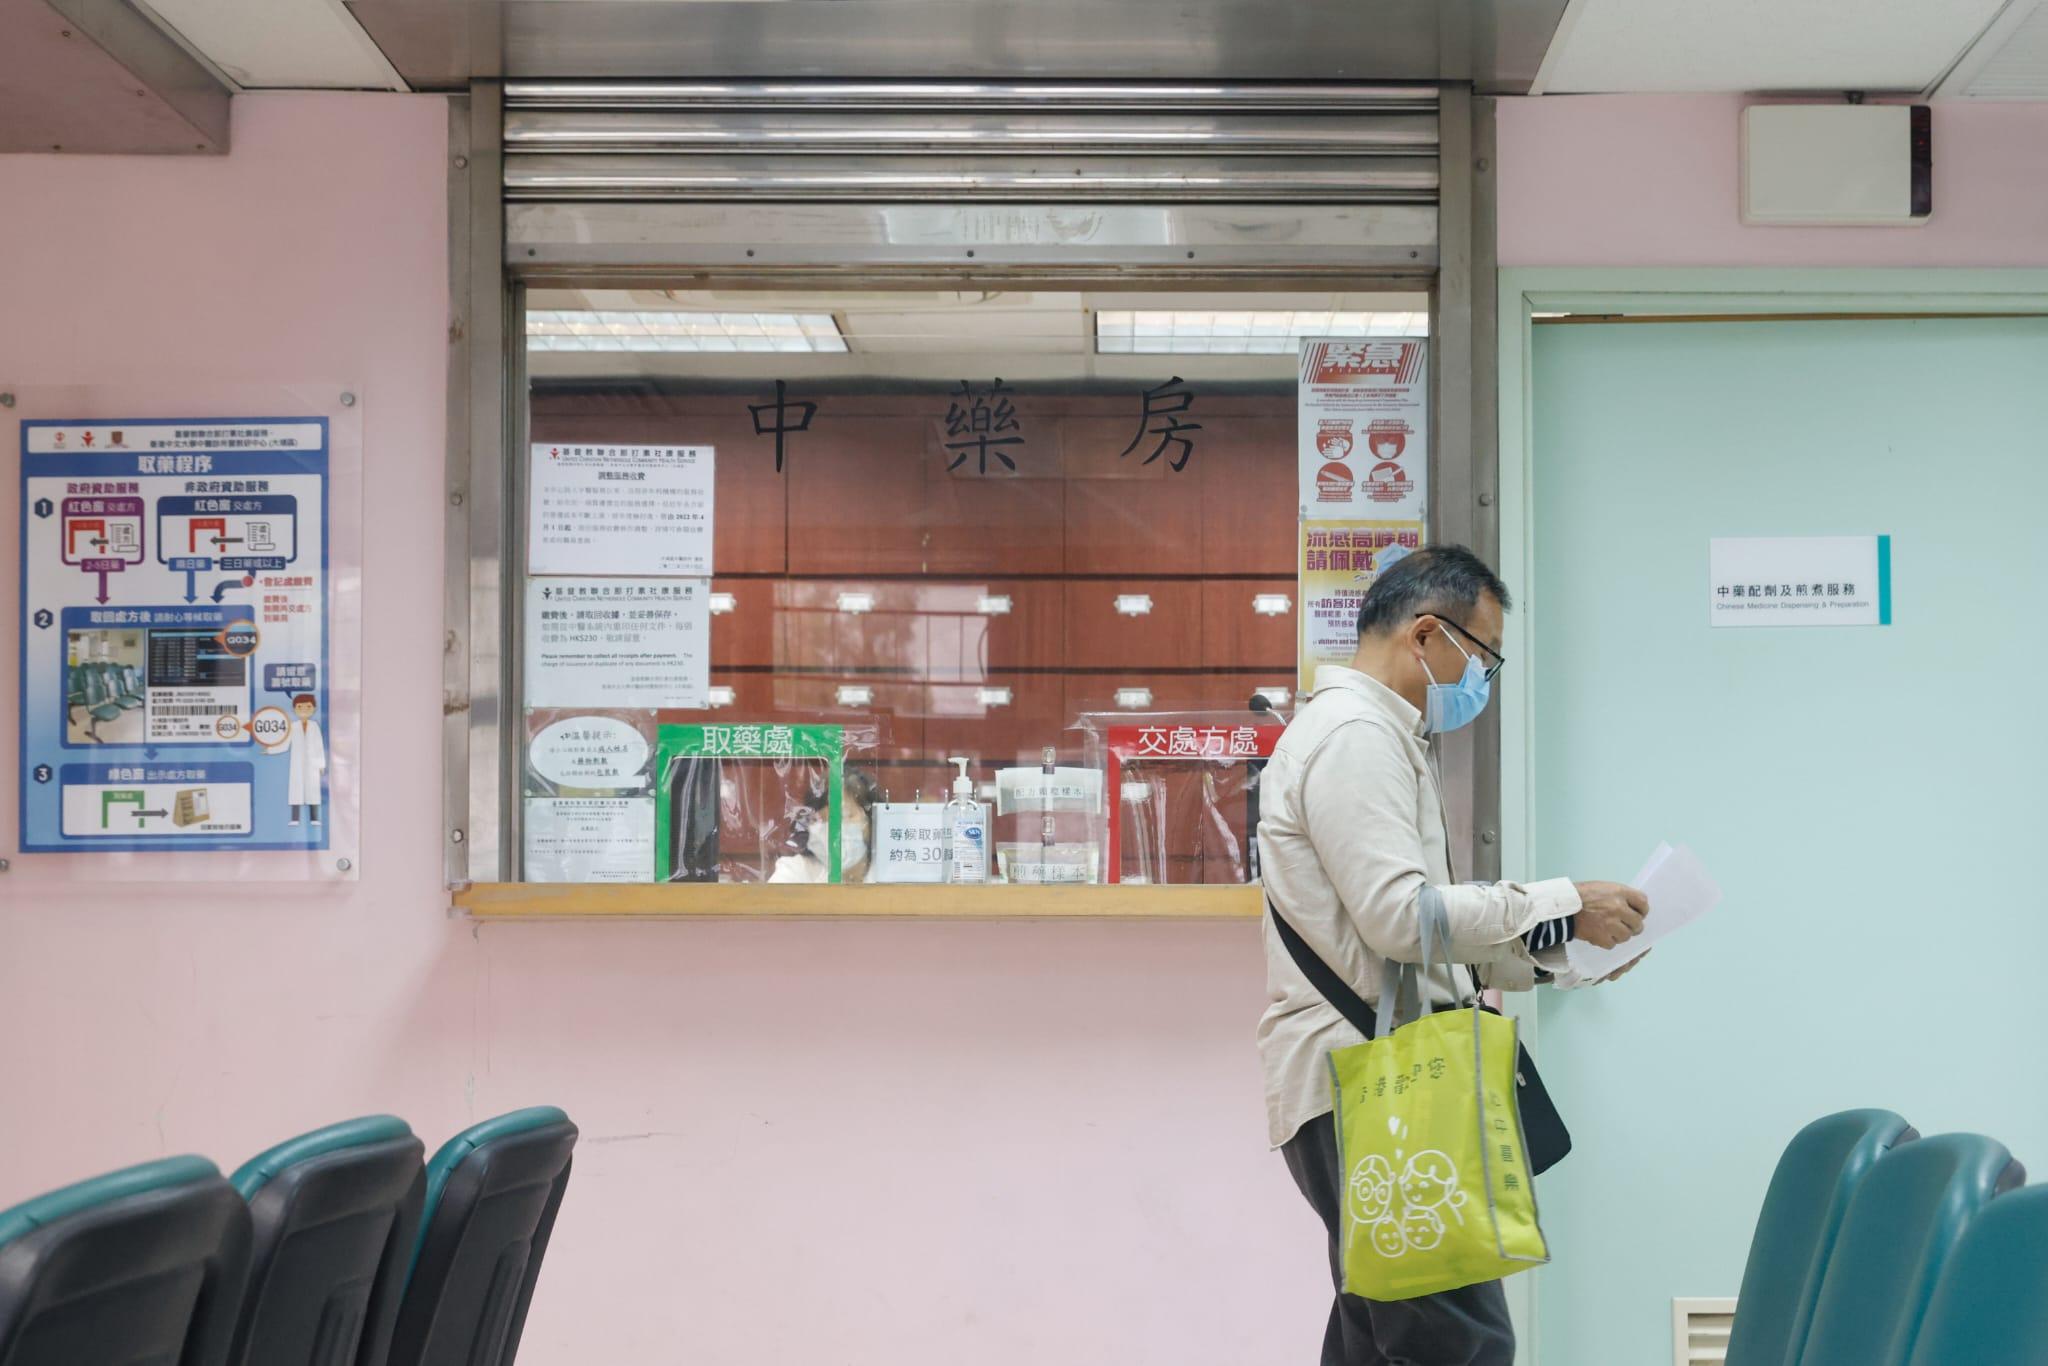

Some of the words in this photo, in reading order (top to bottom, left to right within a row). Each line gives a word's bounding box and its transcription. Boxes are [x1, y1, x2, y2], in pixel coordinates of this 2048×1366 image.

[1322, 343, 1403, 368] 緊急
[748, 375, 1202, 474] 中藥房
[138, 455, 212, 474] 取藥程序
[1307, 528, 1419, 548] 流感高峰期
[1307, 550, 1374, 571] 請佩戴
[1717, 583, 1856, 598] 中藥配劑及煎煮服務
[1716, 602, 1745, 610] Chinese
[1780, 601, 1819, 610] Dispensing
[1829, 601, 1870, 609] Preparation
[254, 719, 287, 733] G034
[702, 725, 794, 754] 取藥處
[1137, 725, 1259, 756] 交處方處
